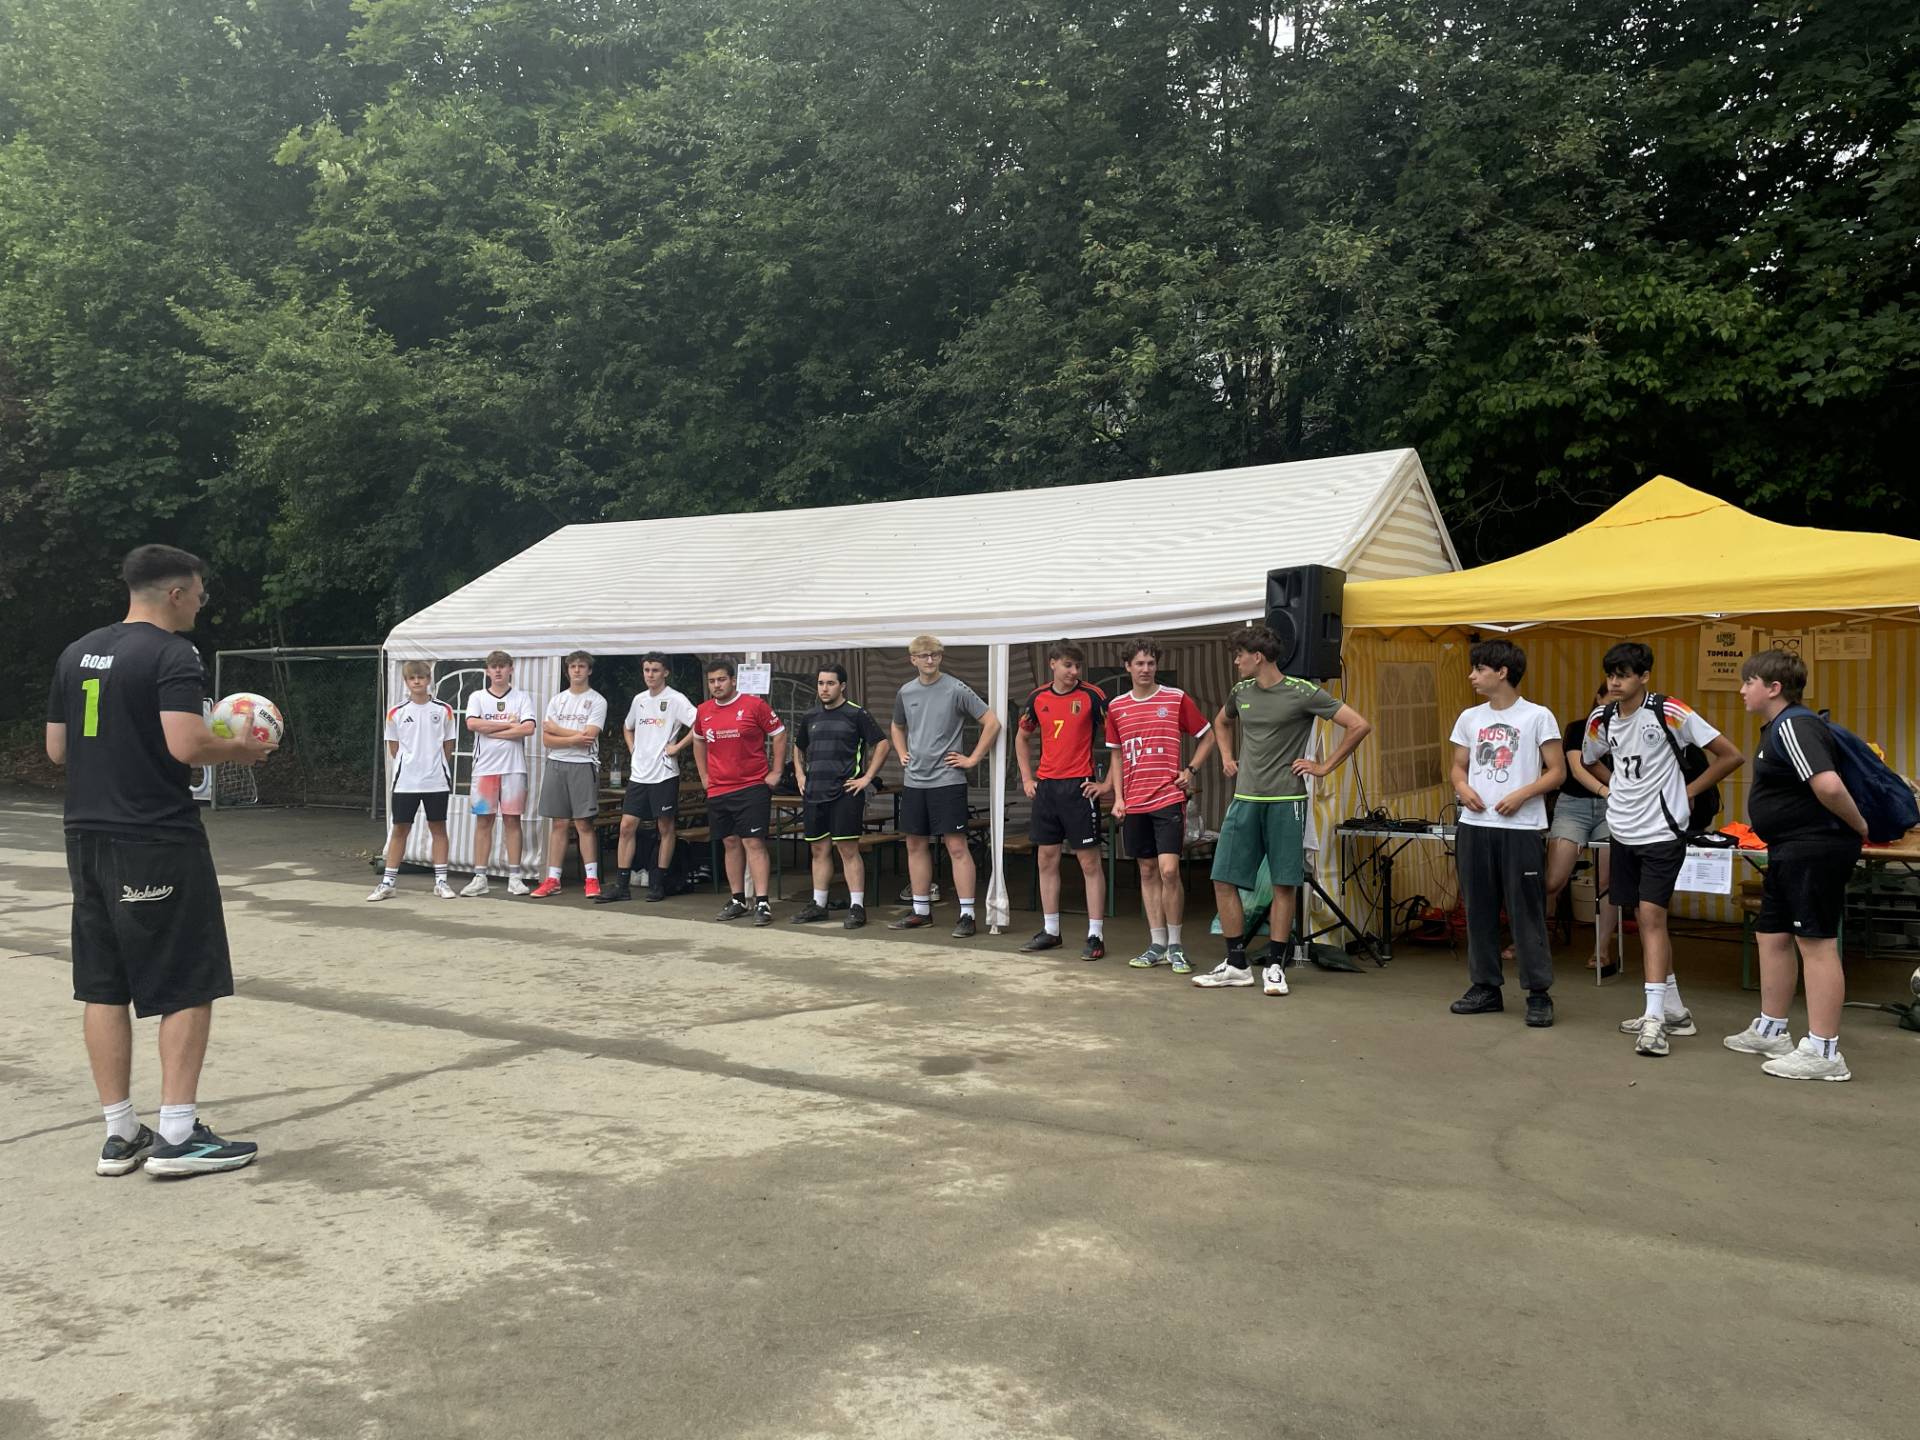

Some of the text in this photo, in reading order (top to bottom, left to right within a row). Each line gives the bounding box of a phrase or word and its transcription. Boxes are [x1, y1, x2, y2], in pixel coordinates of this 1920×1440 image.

[82, 679, 100, 736] 1
[1053, 720, 1065, 739] 7
[1622, 755, 1642, 779] 17
[120, 884, 174, 902] Dickies
